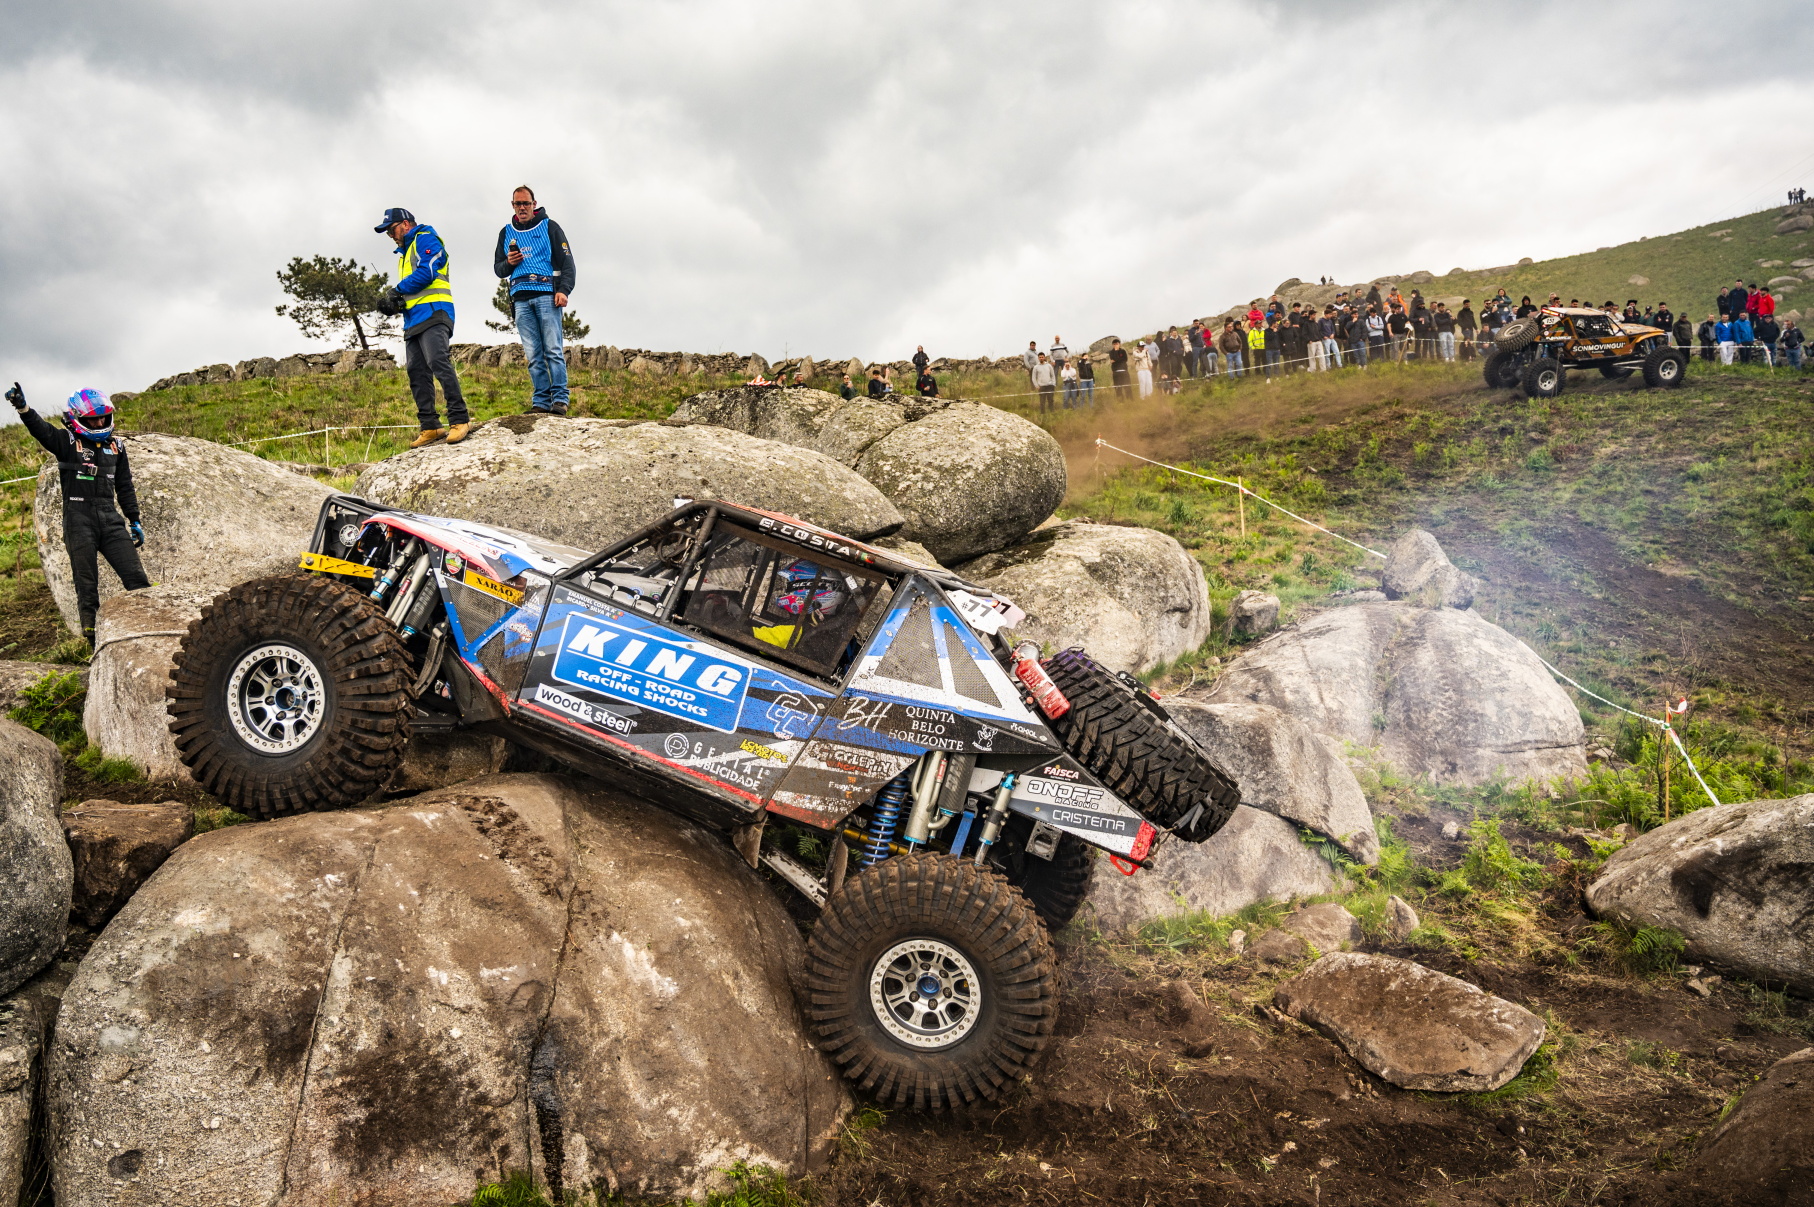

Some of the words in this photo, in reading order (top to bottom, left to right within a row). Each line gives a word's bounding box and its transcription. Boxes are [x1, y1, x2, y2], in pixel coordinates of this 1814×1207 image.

[961, 599, 992, 617] #77
[567, 624, 742, 697] KING
[576, 670, 640, 697] RACING
[643, 691, 708, 717] SHOCKS
[599, 666, 632, 684] OFF
[644, 681, 696, 702] ROAD
[541, 689, 582, 712] wood
[905, 705, 956, 724] QUINTA
[911, 720, 945, 735] BELO
[888, 728, 964, 752] HORIZONTE
[689, 753, 761, 791] PUBLICIDADE
[1043, 767, 1080, 780] FAISCA
[1055, 798, 1099, 810] RACING
[1052, 810, 1125, 831] CRISTEMA
